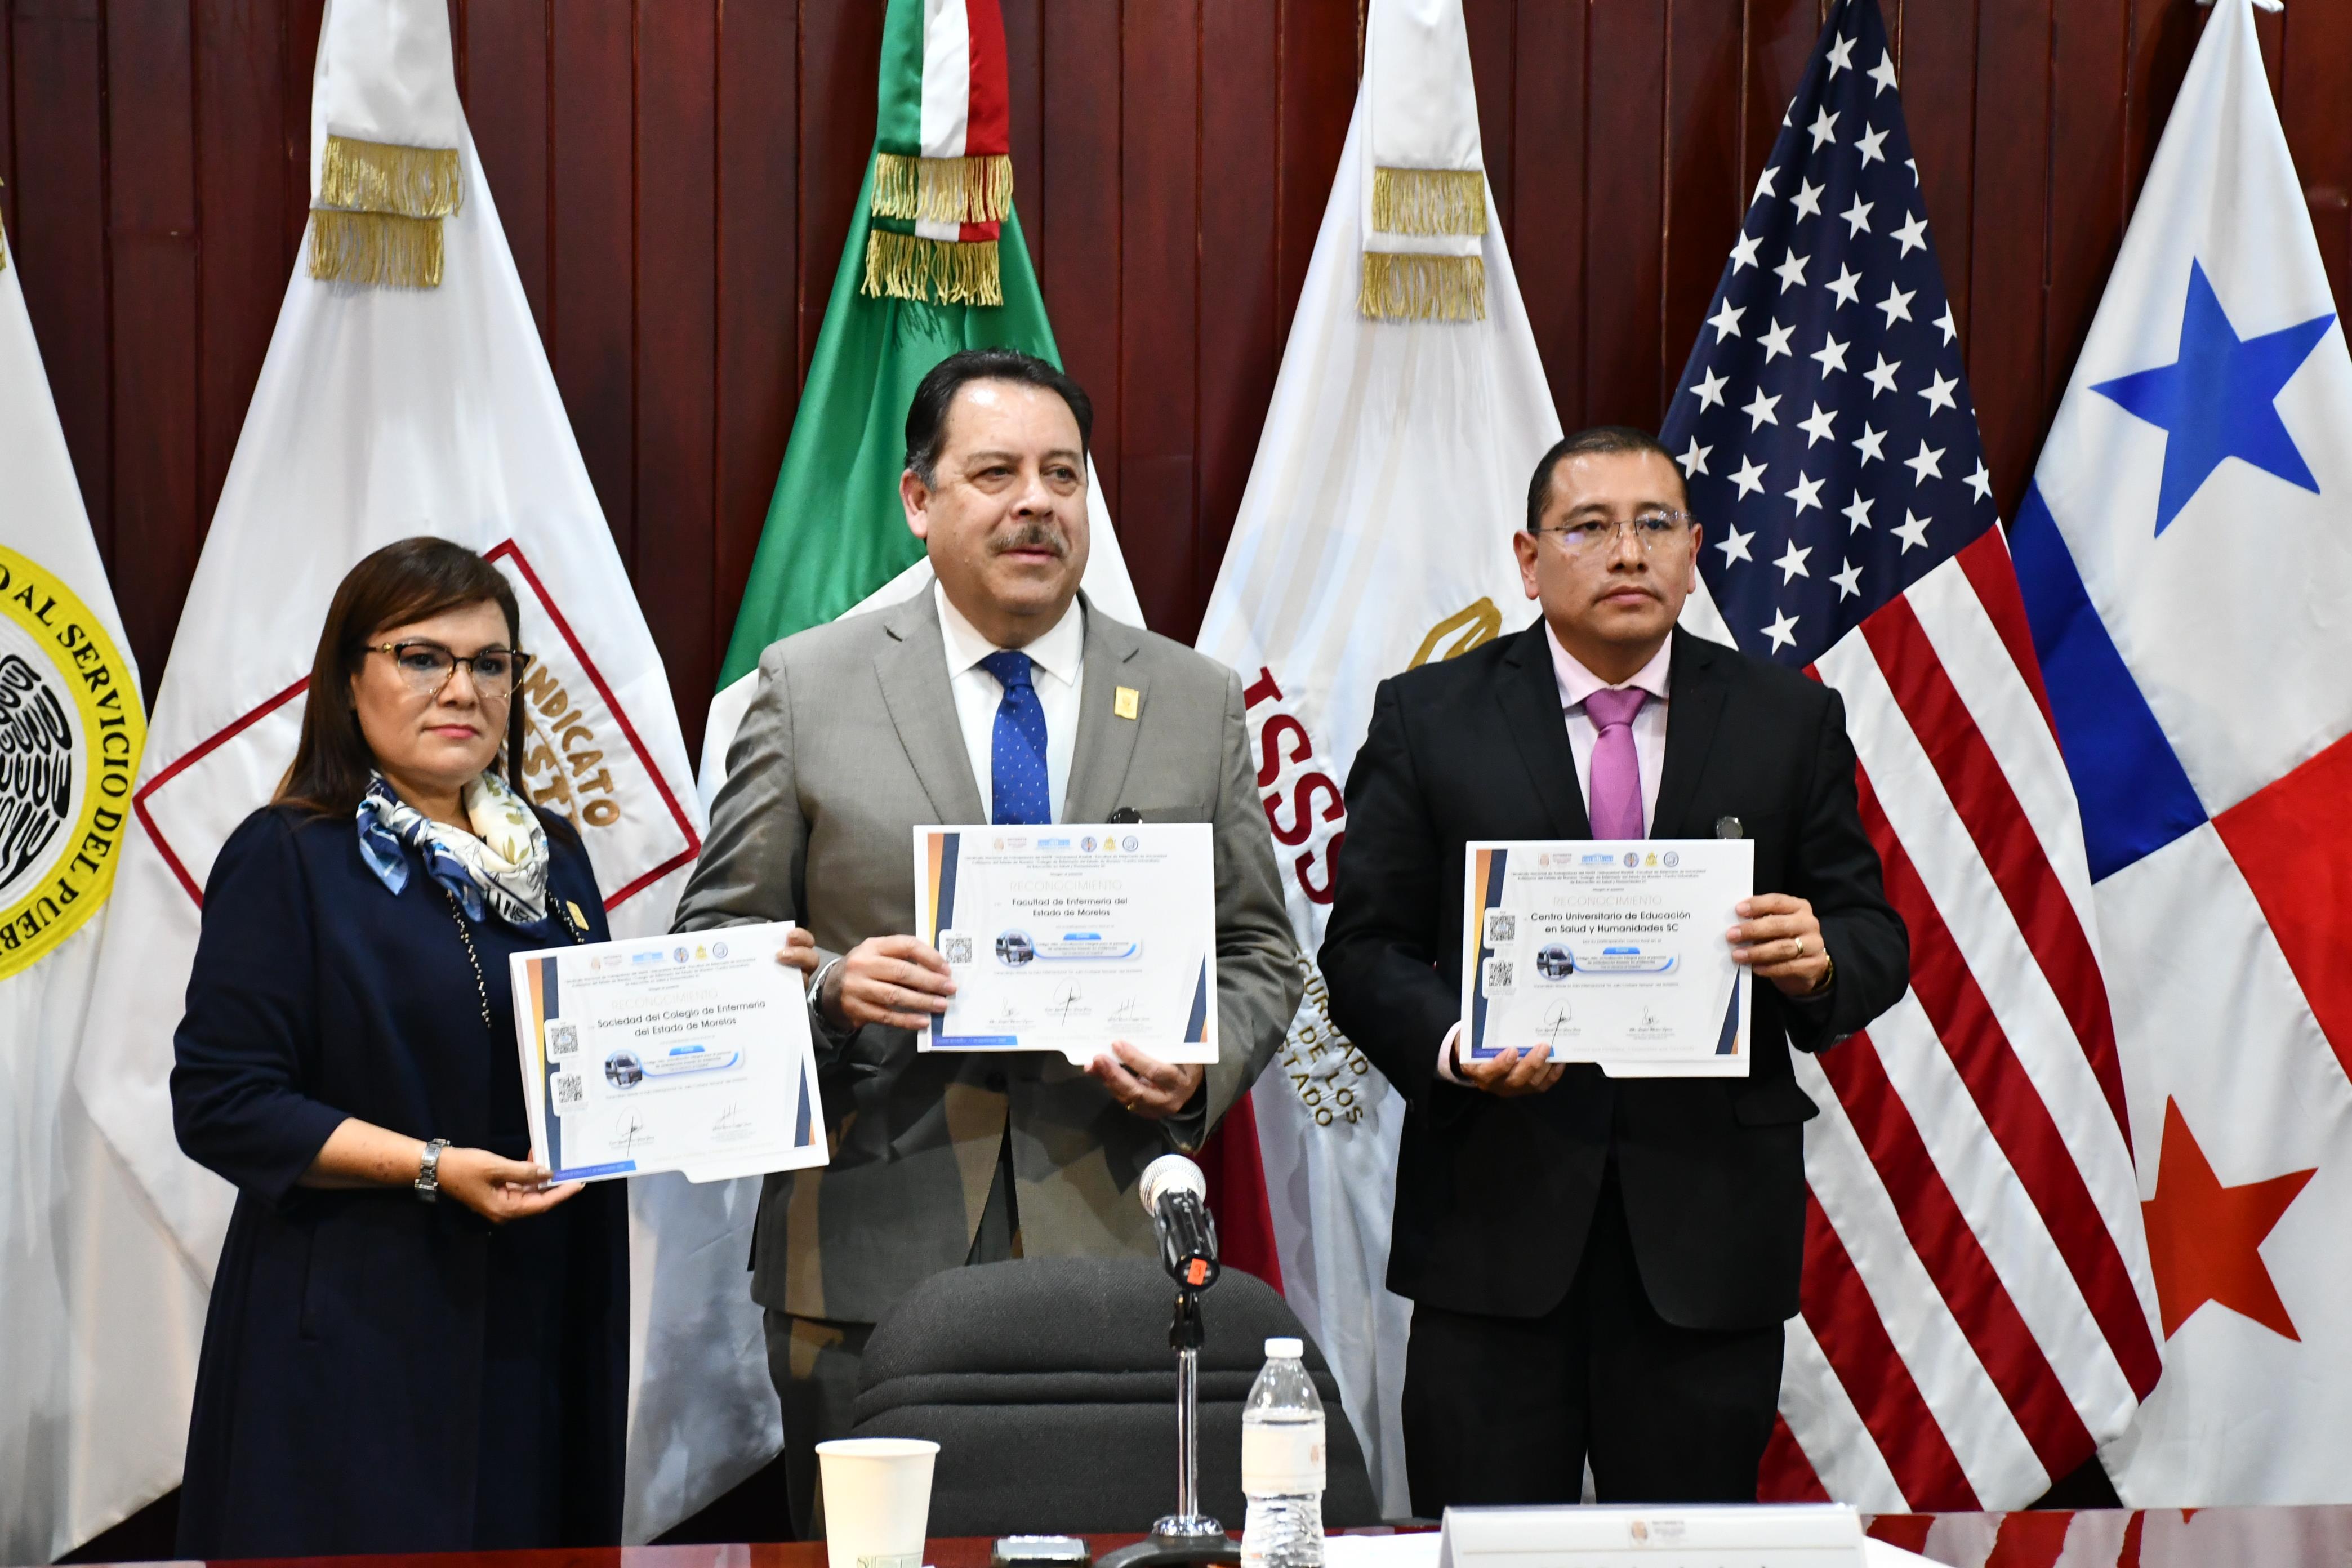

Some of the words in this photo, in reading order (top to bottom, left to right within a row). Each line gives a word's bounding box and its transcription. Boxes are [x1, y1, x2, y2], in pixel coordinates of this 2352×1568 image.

[13, 584, 57, 626] AL
[56, 624, 130, 798] SERVICIO
[523, 654, 620, 827] INDICATO
[70, 807, 122, 874] DEL
[1010, 879, 1122, 892] RECONOCIMIENTO
[1012, 898, 1050, 906] Facultad
[1553, 894, 1662, 907] RECONOCIMIENTO
[0, 877, 79, 955] PUEB
[1531, 912, 1563, 921] Centro
[1566, 911, 1622, 921] Universitario
[1625, 911, 1637, 920] de
[1640, 910, 1691, 920] Educación
[1560, 924, 1586, 933] Salud
[1589, 926, 1594, 935] y
[1597, 924, 1664, 933] Humanidades
[1667, 923, 1679, 932] SC
[598, 1015, 643, 1028] Sociedad
[645, 1012, 661, 1022] del
[663, 1008, 700, 1020] Colegio
[702, 1006, 715, 1015] de
[634, 1028, 649, 1037] del
[652, 1023, 684, 1035] Estado
[686, 1021, 698, 1030] de
[701, 1016, 737, 1028] Morelos
[1298, 1025, 1328, 1063] DE
[1325, 1070, 1364, 1124] LOS
